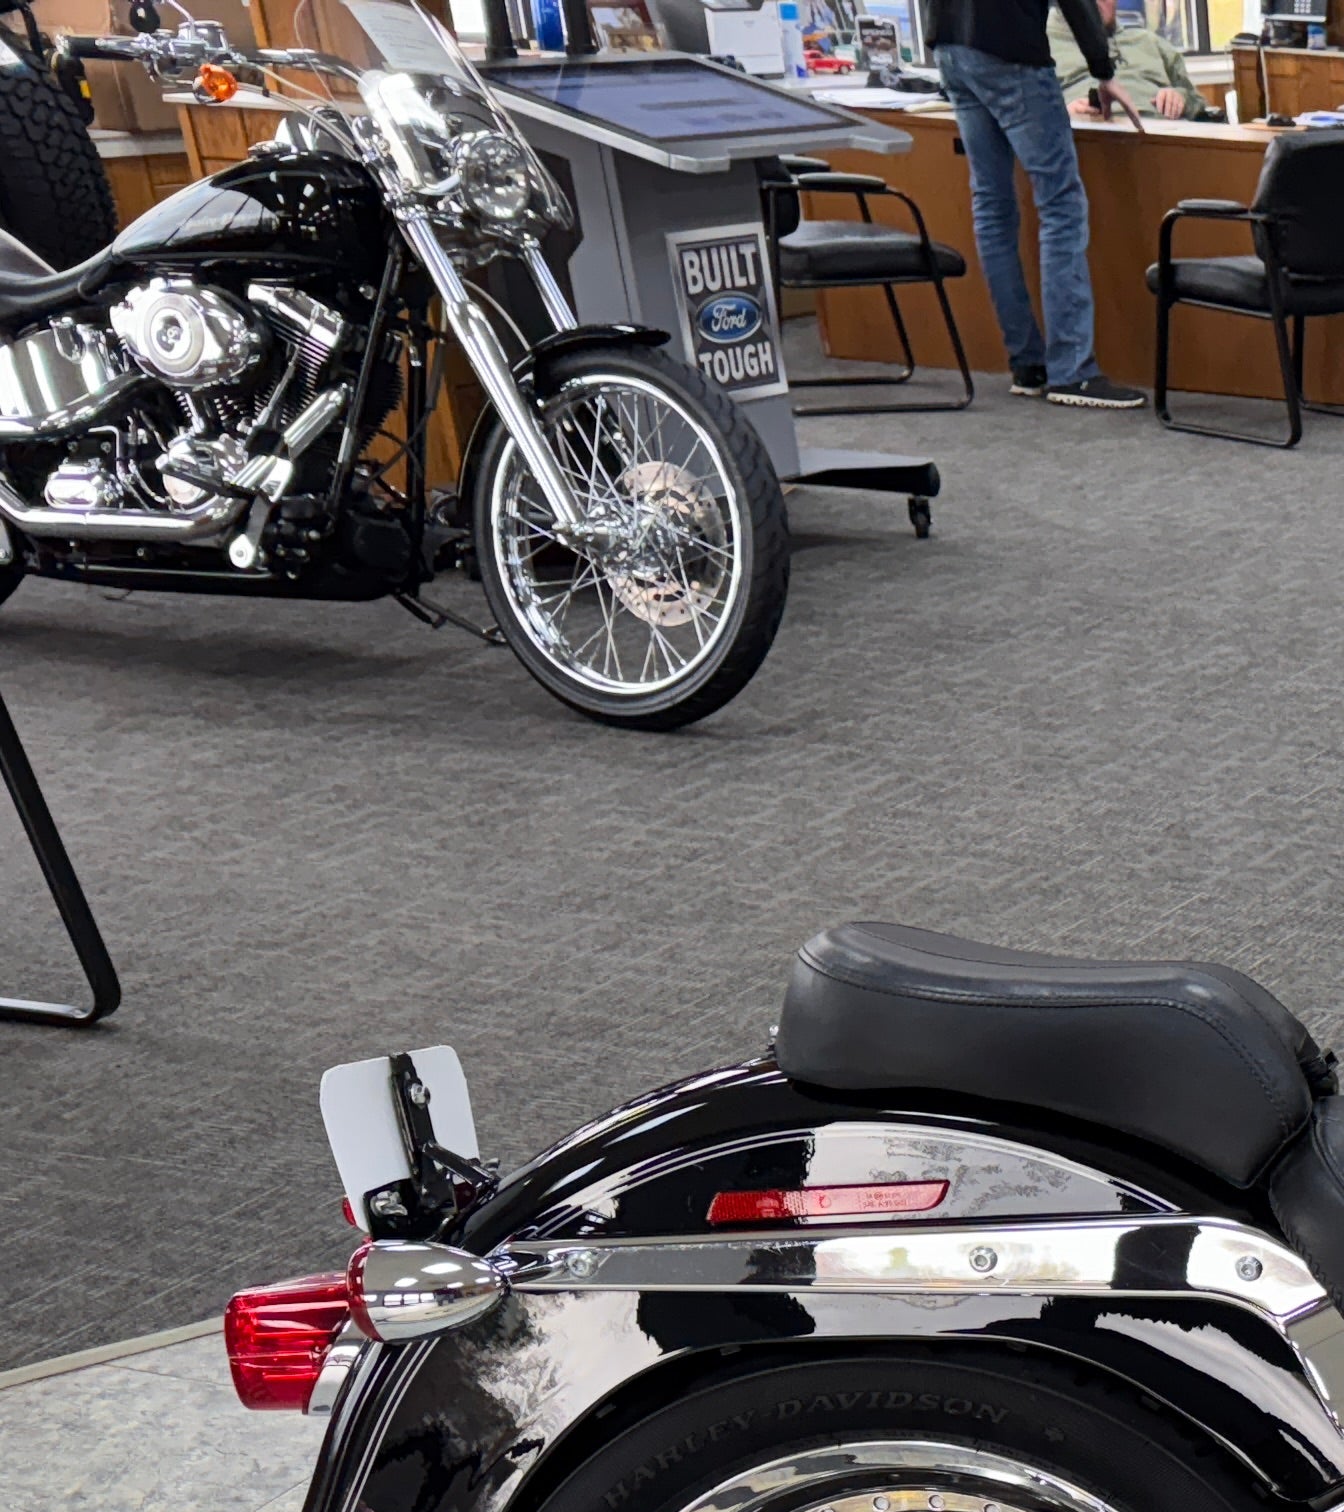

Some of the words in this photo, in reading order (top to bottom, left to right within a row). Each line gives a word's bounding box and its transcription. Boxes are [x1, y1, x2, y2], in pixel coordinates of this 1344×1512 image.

[681, 243, 758, 295] BUILT
[711, 303, 747, 332] Ford
[698, 341, 774, 385] TOUGH
[600, 1388, 1014, 1511] HARLEY-DAVIDSON
